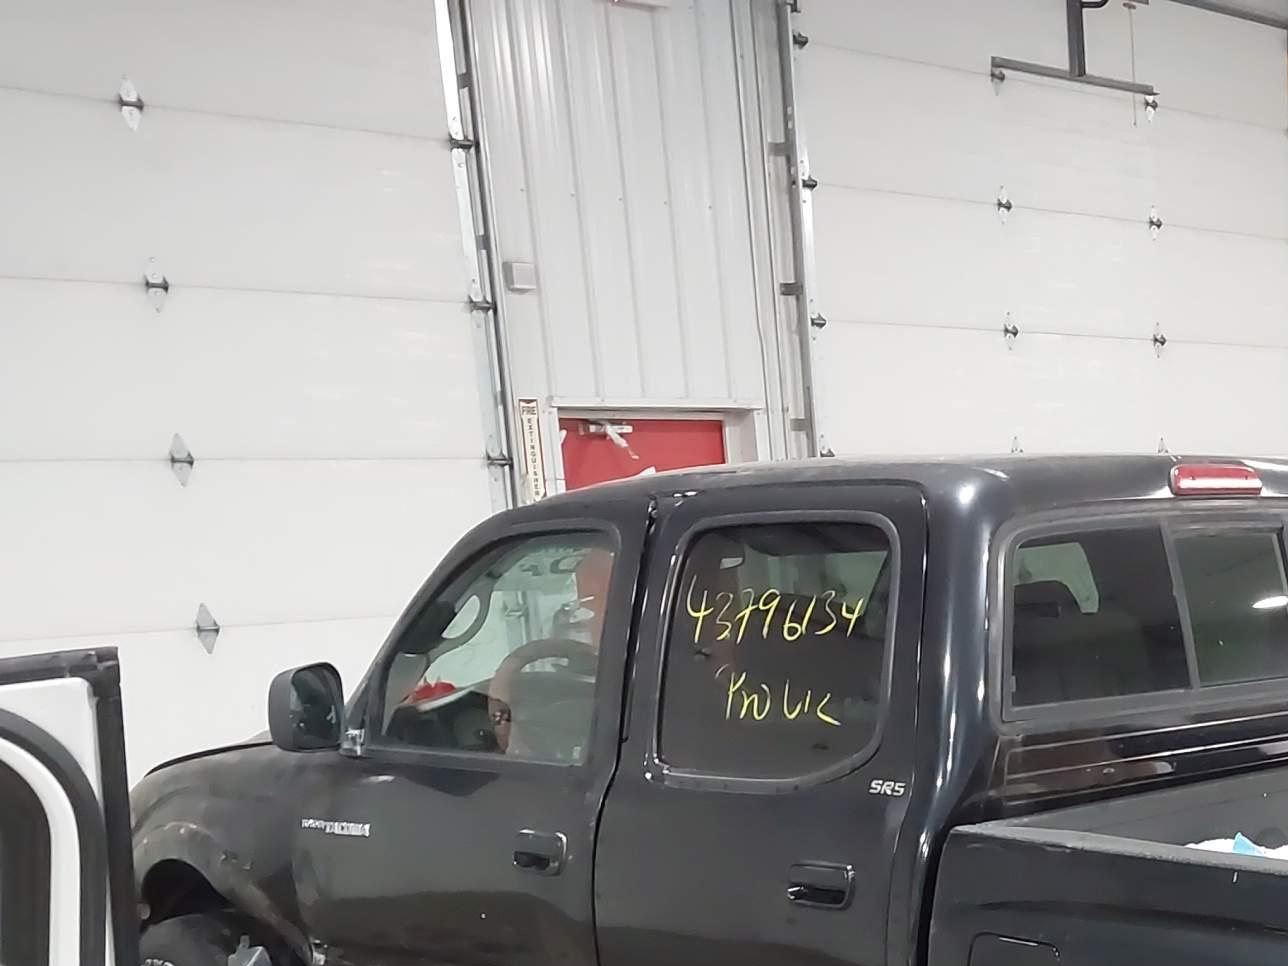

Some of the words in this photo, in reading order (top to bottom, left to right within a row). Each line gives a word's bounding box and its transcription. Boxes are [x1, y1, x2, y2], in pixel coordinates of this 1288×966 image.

[521, 405, 537, 416] FIRE
[686, 574, 865, 644] 43796134
[868, 779, 907, 797] SR5
